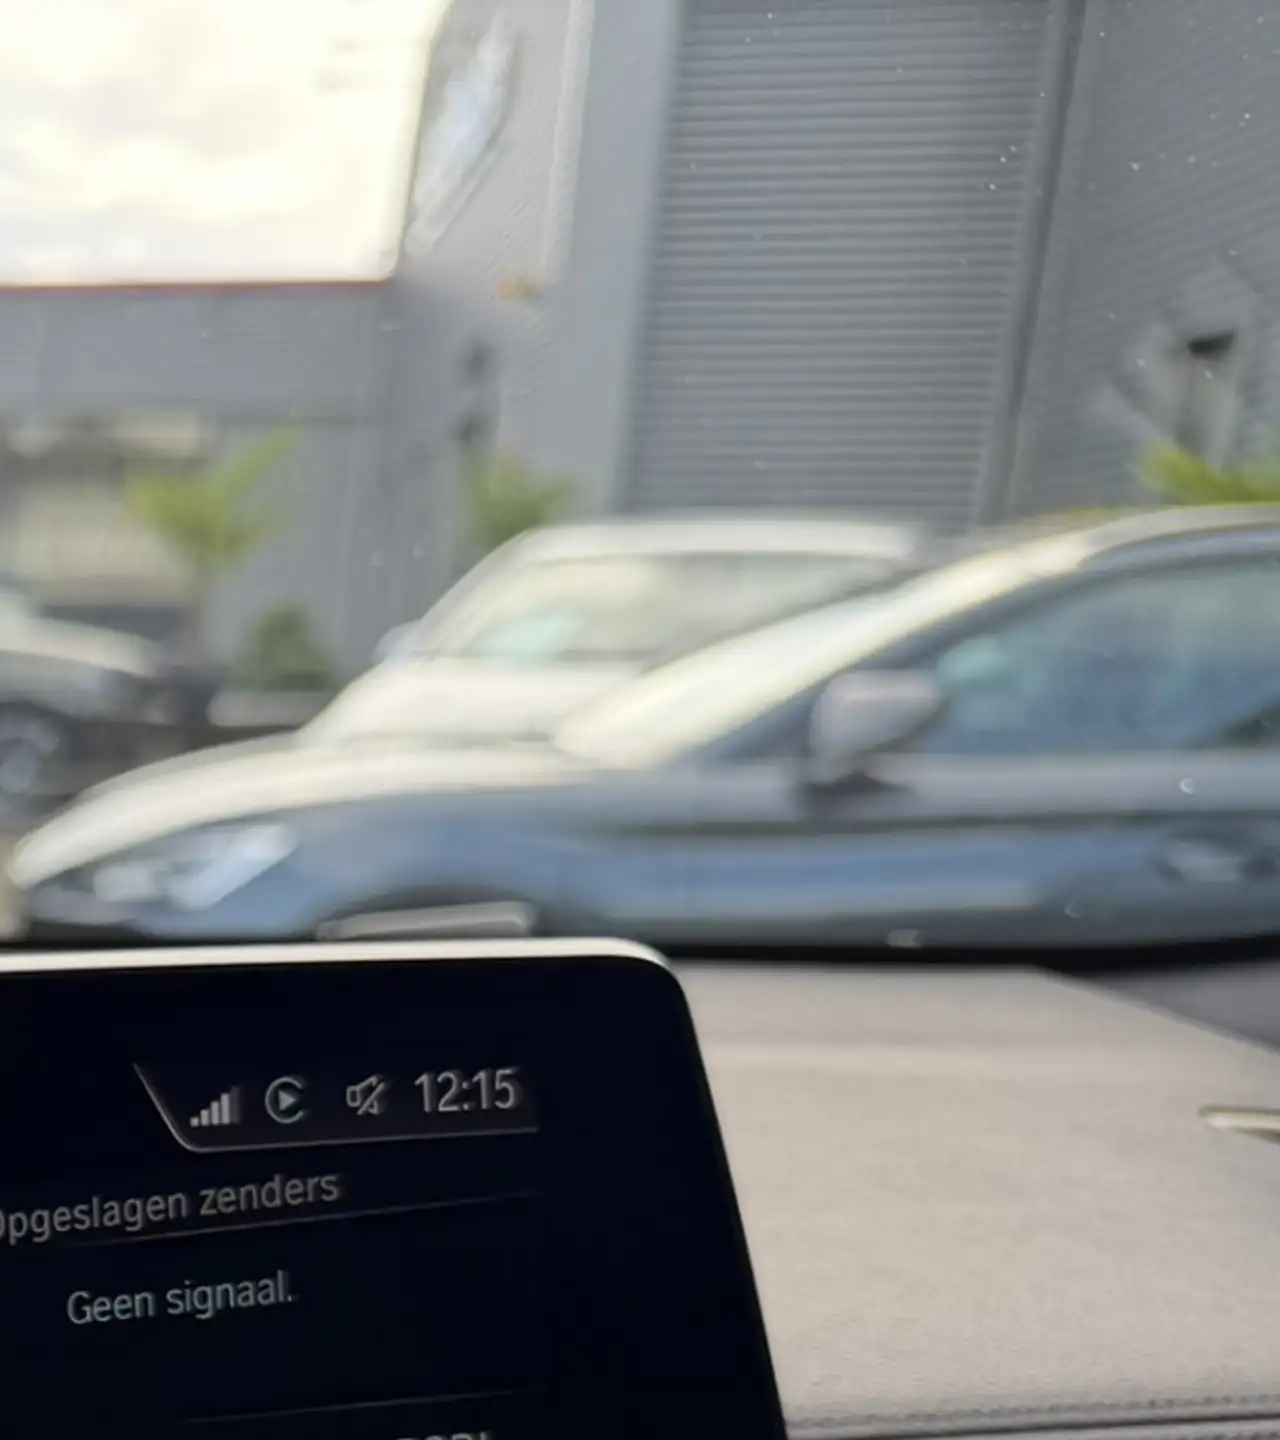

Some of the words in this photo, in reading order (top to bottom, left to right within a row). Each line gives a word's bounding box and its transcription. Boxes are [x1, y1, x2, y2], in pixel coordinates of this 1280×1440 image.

[414, 1067, 518, 1113] 12:15
[199, 1173, 340, 1217] zenders
[66, 1289, 155, 1325] Geen
[164, 1269, 295, 1320] signaal.
